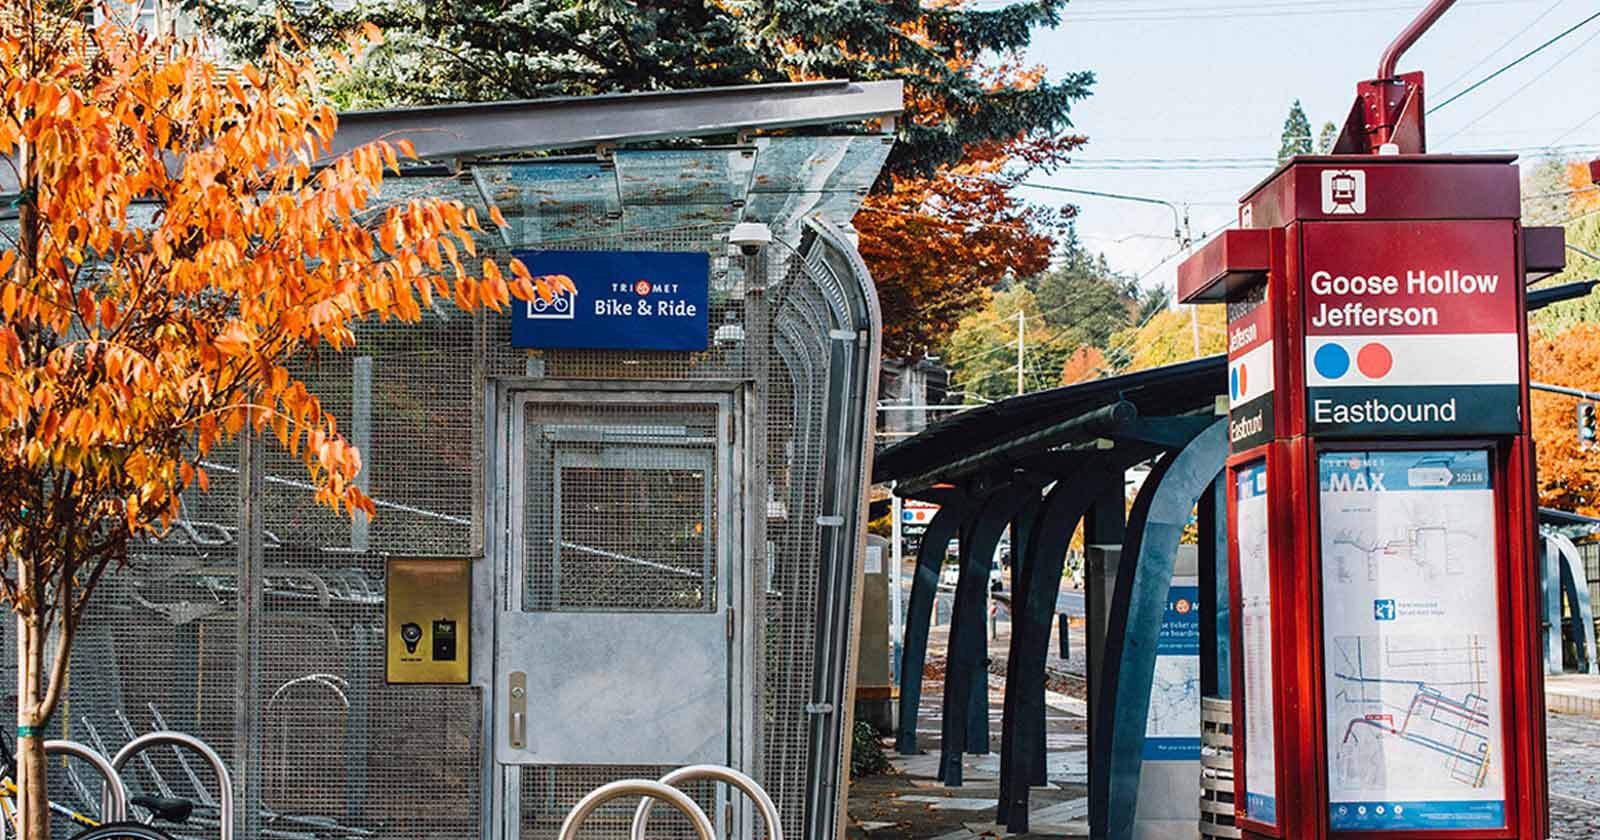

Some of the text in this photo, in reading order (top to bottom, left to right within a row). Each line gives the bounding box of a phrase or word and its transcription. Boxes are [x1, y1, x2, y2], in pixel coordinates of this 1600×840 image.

[1311, 270, 1499, 295] Goose Hollow
[595, 299, 696, 316] Bike & Ride
[1312, 303, 1438, 327] Jefferson
[1230, 323, 1257, 353] Jefferson
[1314, 398, 1456, 423] Eastbound
[1231, 409, 1264, 442] Eastbound
[1330, 472, 1386, 493] MAX
